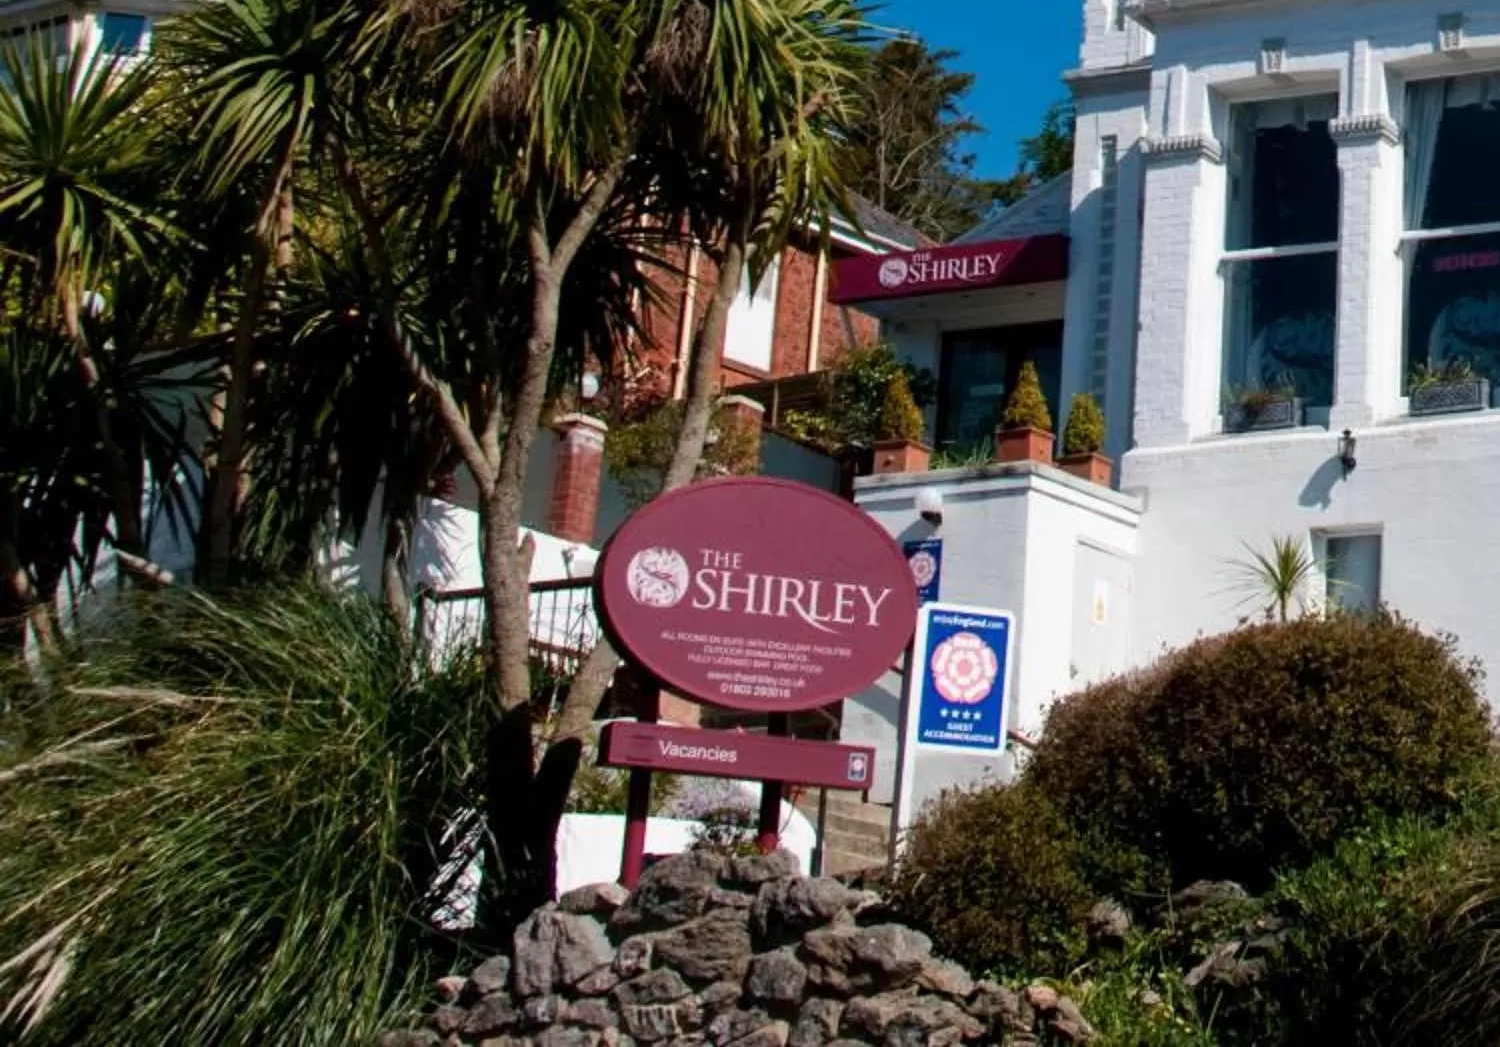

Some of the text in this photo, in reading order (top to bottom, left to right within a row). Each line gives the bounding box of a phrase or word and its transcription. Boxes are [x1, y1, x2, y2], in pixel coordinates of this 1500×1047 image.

[908, 252, 1003, 283] SHIRLEY
[700, 549, 743, 570] THE
[692, 568, 893, 634] SHIRLEY
[659, 740, 737, 763] Vacancies
